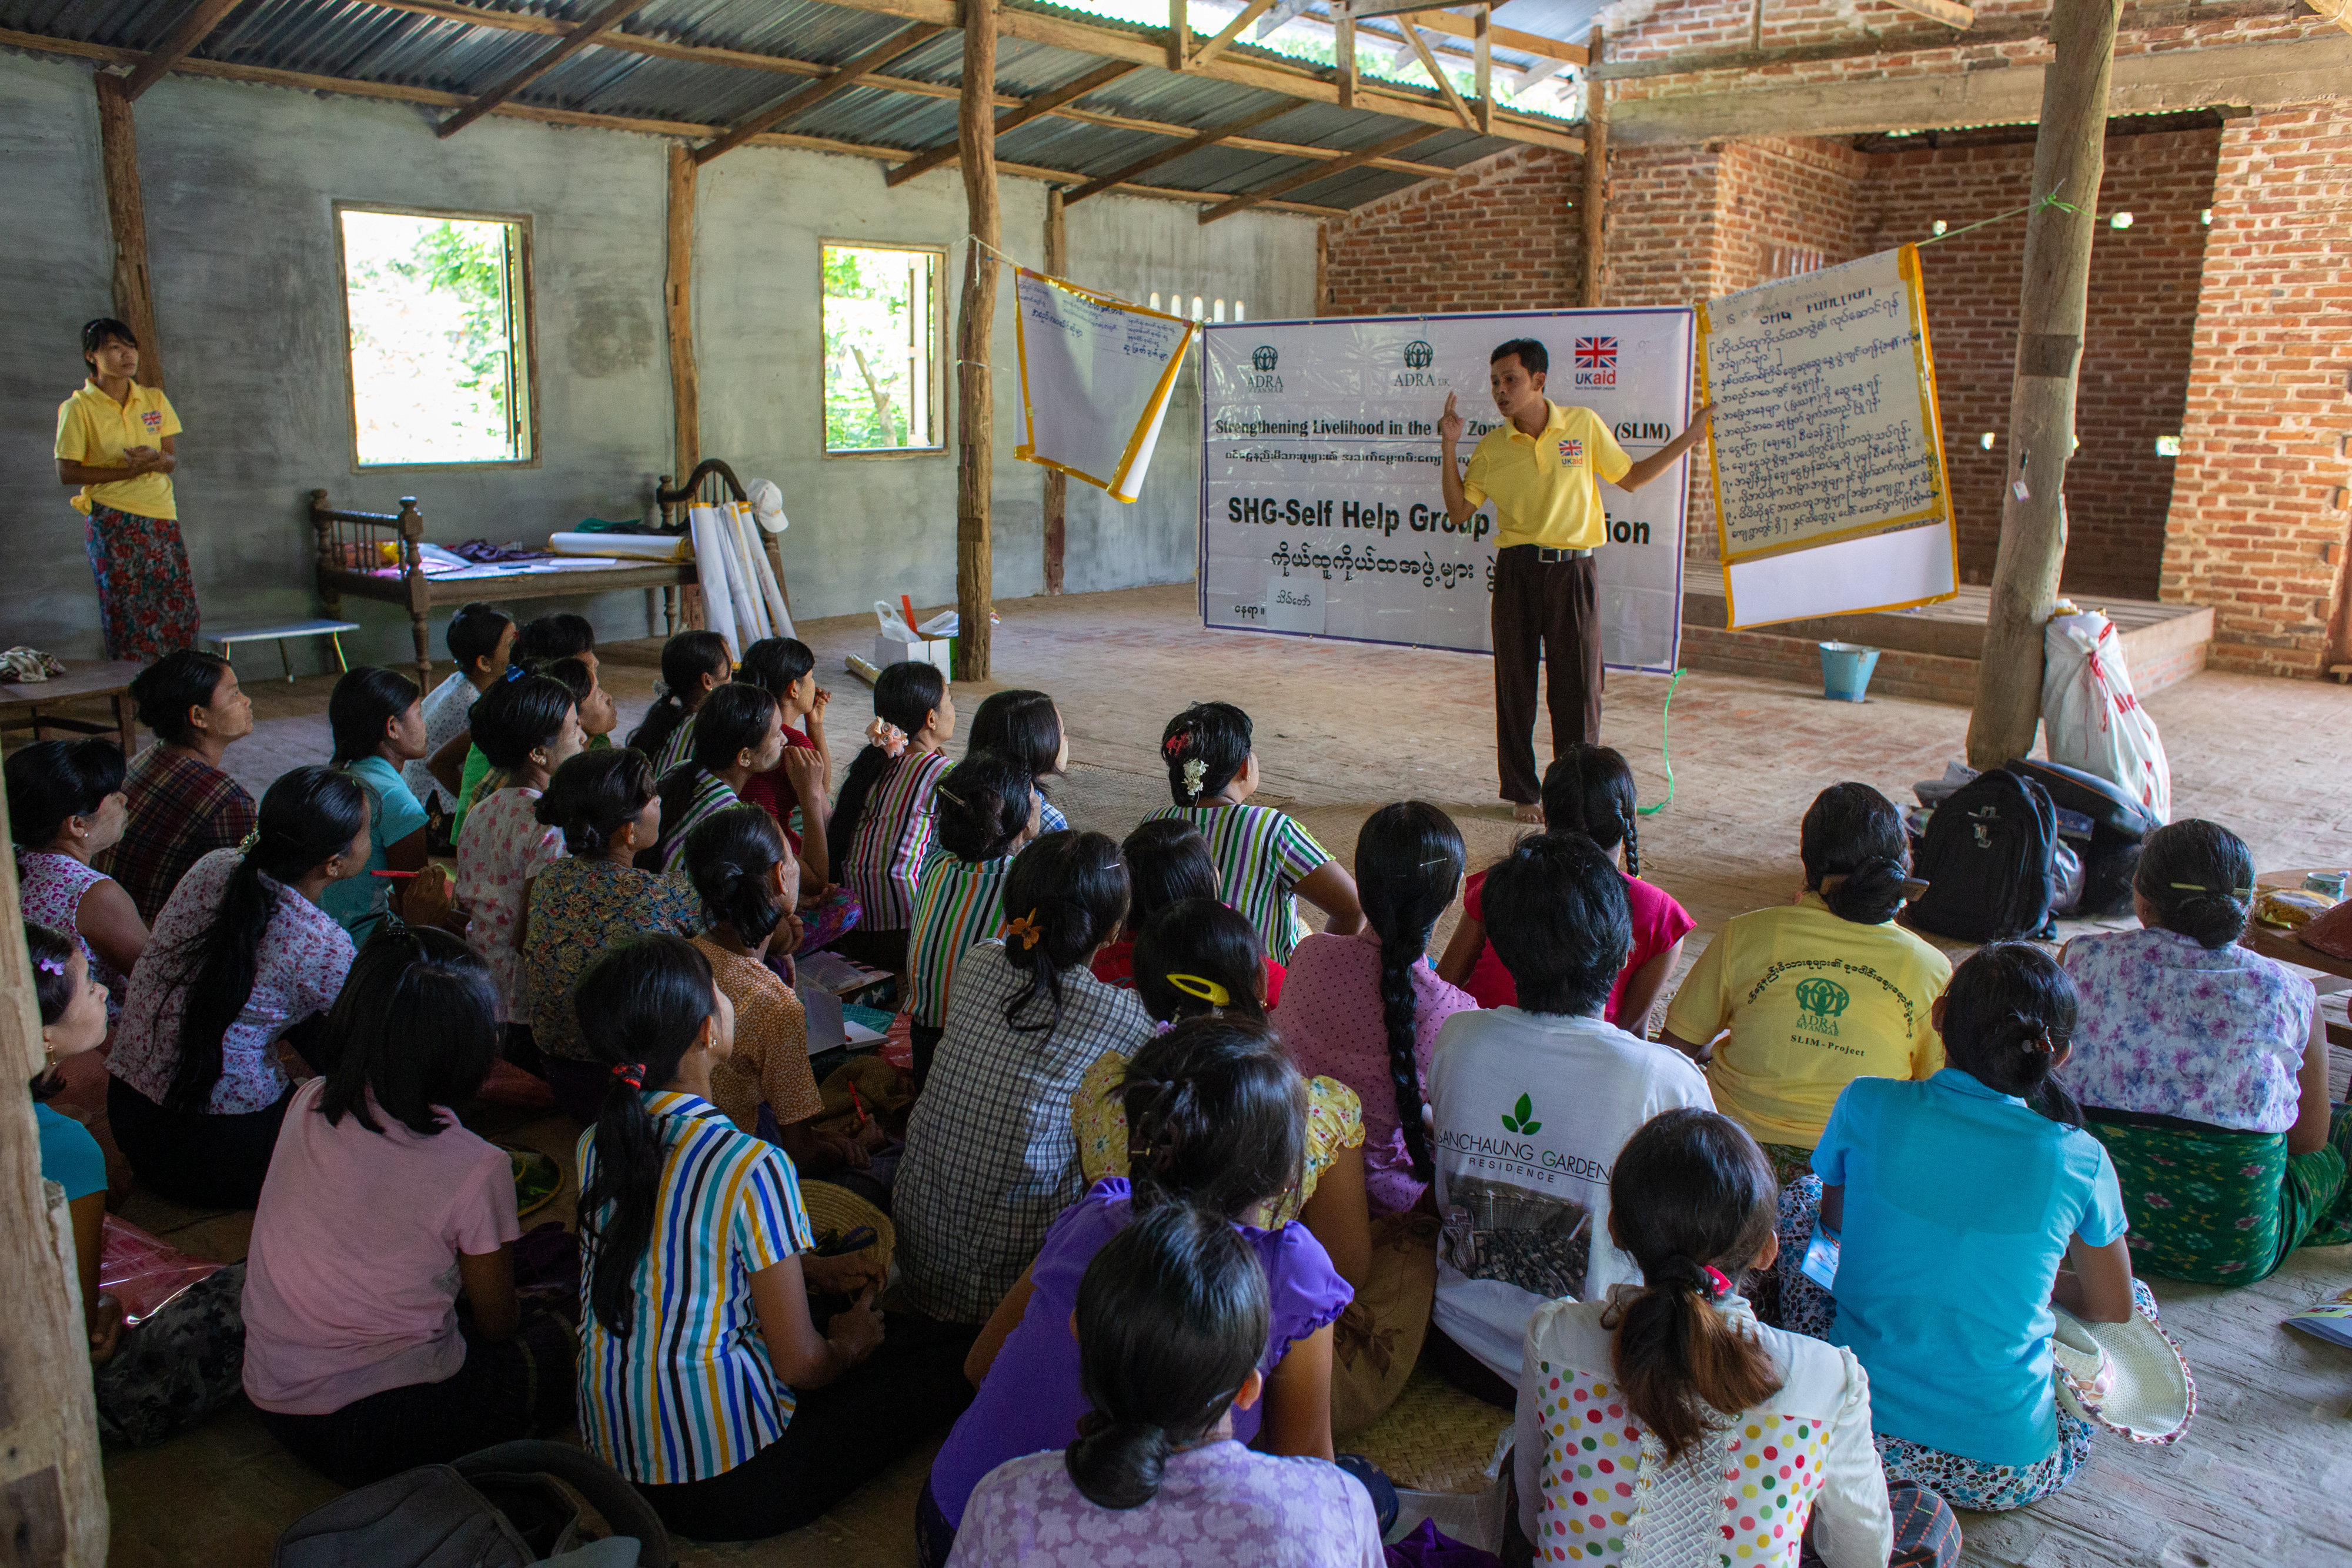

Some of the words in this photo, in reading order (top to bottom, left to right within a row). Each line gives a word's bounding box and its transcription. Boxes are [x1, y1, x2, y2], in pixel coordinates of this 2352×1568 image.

[1248, 375, 1284, 387] ADRA
[1394, 373, 1435, 386] ADRA
[1438, 378, 1450, 386] UK
[1215, 420, 1308, 437] Strengthening
[1313, 420, 1384, 436] Livelihood
[1389, 420, 1403, 435] in
[1408, 420, 1431, 436] the
[1467, 420, 1504, 436] Zon
[1614, 422, 1671, 443] (SLIM)
[1228, 496, 1333, 527] SHG-Self
[1342, 500, 1400, 537] Help
[1796, 1022, 1839, 1037] MYANMAR
[1797, 1014, 1839, 1031] ADRA
[1469, 1157, 1554, 1183] RESIDENCE
[1542, 1150, 1612, 1181] GARDEN
